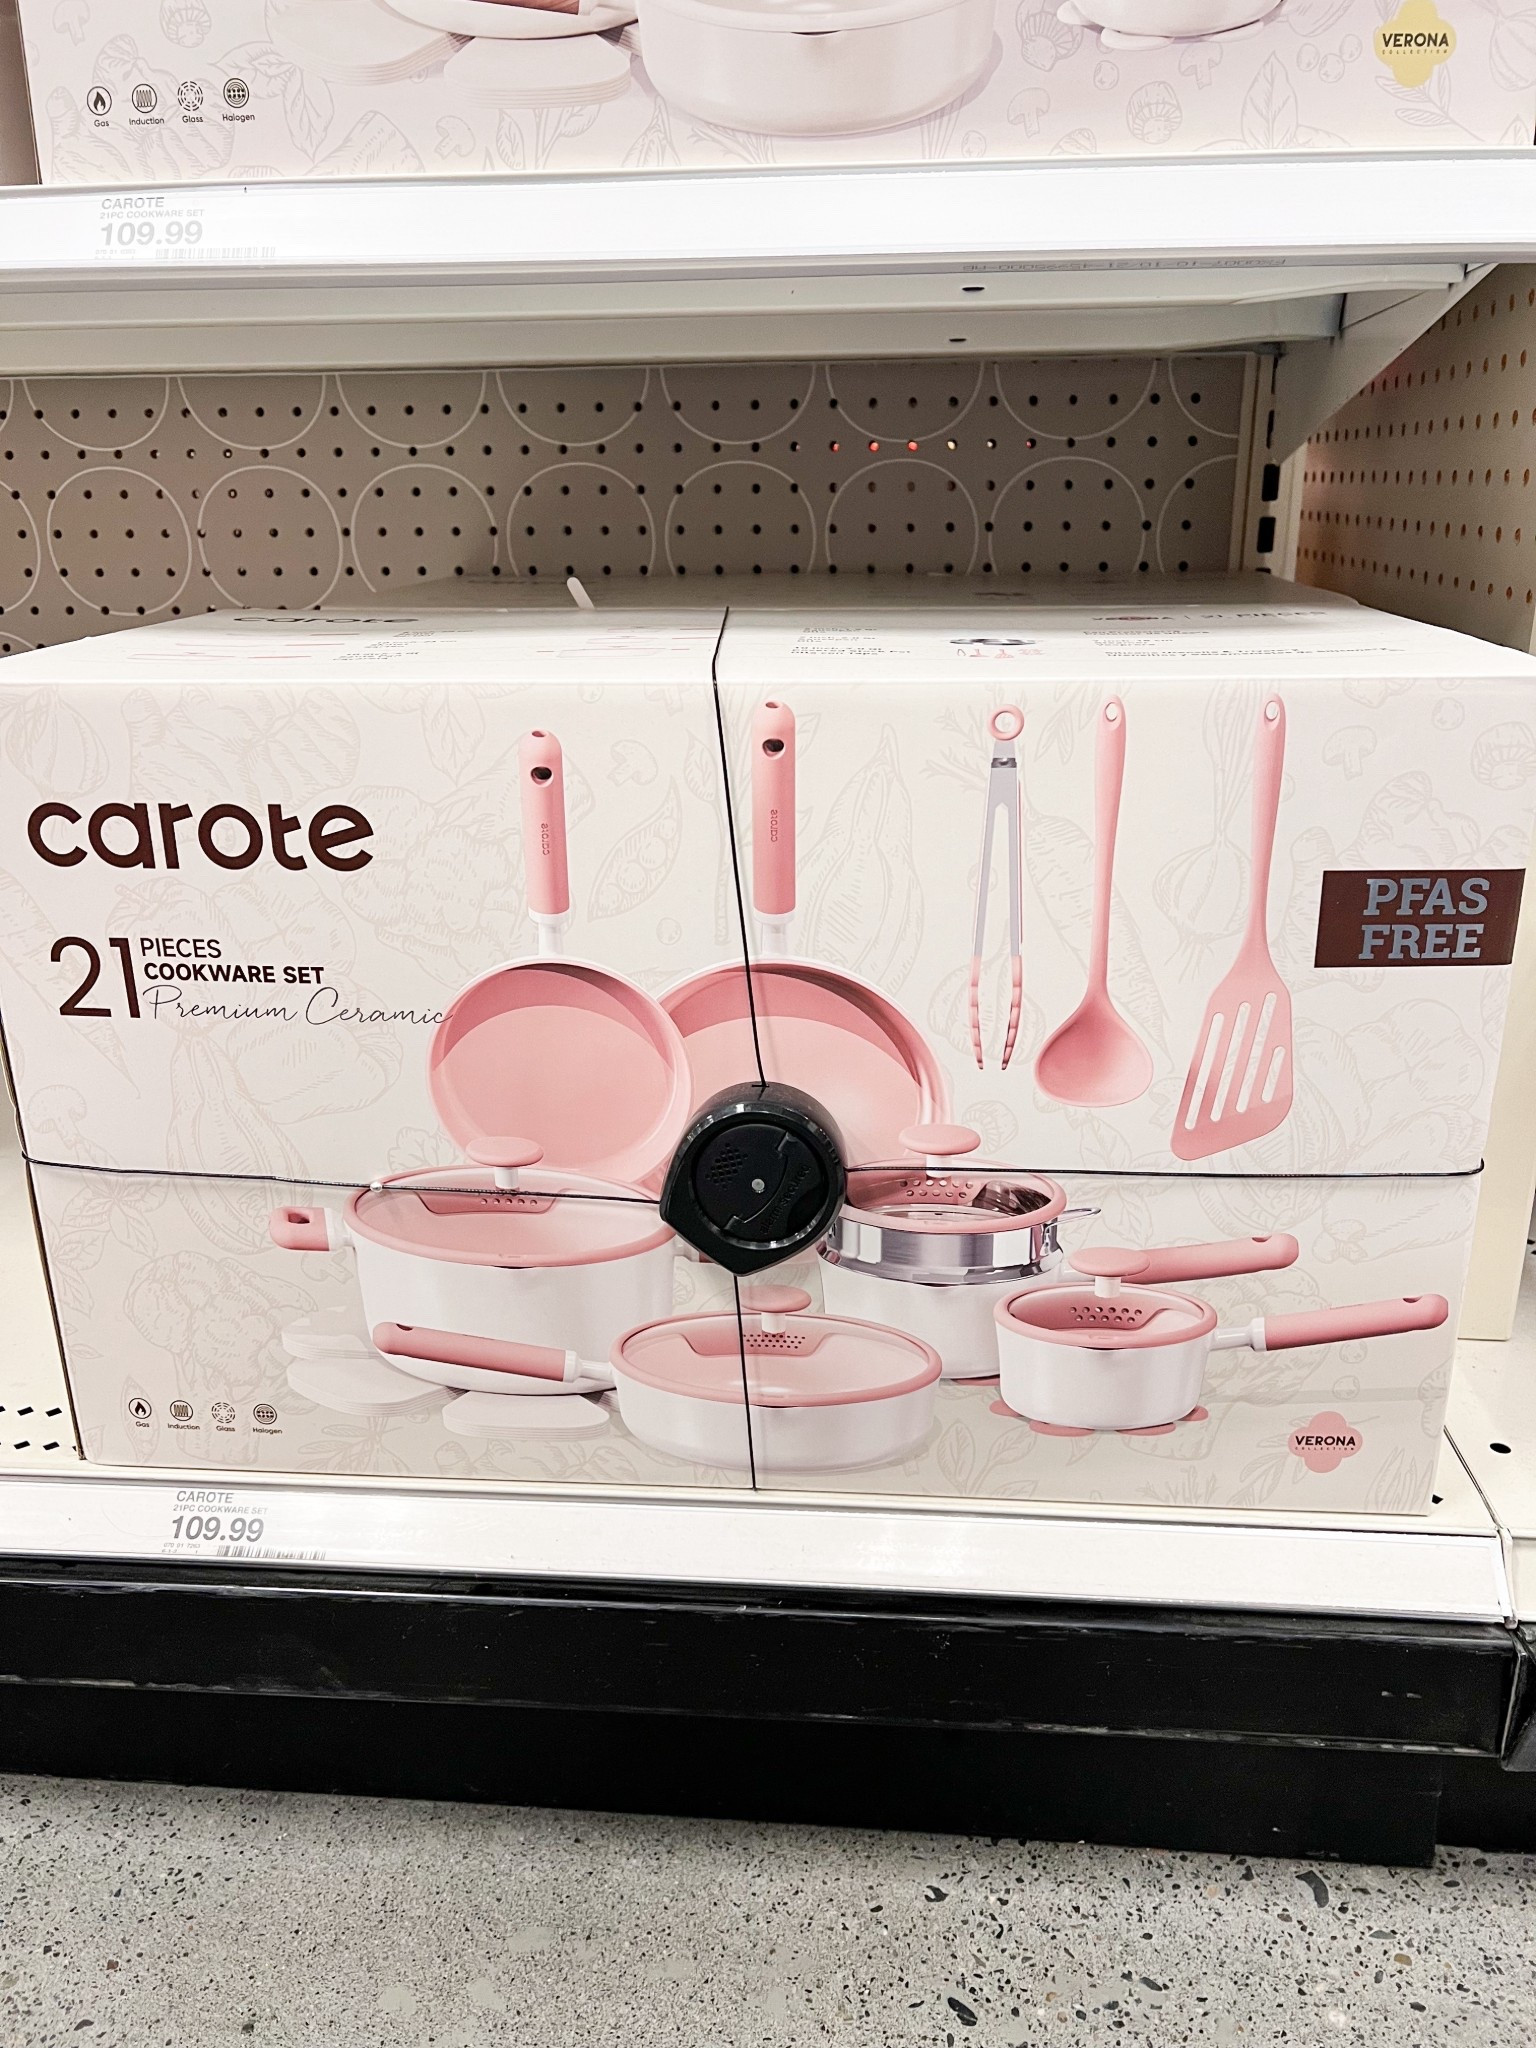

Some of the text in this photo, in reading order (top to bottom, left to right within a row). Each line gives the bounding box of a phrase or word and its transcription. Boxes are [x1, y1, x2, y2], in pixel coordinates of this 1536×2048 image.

[1382, 32, 1449, 48] VERONA
[94, 119, 110, 128] Gas
[129, 117, 165, 126] Induction
[182, 115, 204, 123] Glass
[222, 113, 256, 123] Halogen
[101, 196, 165, 210] CAROTE
[99, 208, 205, 220] 21PC COOKWARE SET
[100, 220, 203, 246] 109.99
[770, 809, 778, 843] carote
[27, 801, 374, 872] carote
[1362, 877, 1491, 916] PFAS
[140, 937, 222, 959] PIECES
[1358, 923, 1485, 960] FREE
[50, 936, 141, 1019] 21
[143, 962, 325, 985] COOKWARE SET
[142, 984, 454, 1026] Premium Ceramic
[252, 1427, 283, 1435] Halogen
[1295, 1435, 1356, 1446] VERONA
[176, 1490, 234, 1504] CAROTE
[173, 1504, 268, 1515] 21PC COOKWARE SET
[171, 1515, 264, 1543] 109.99
